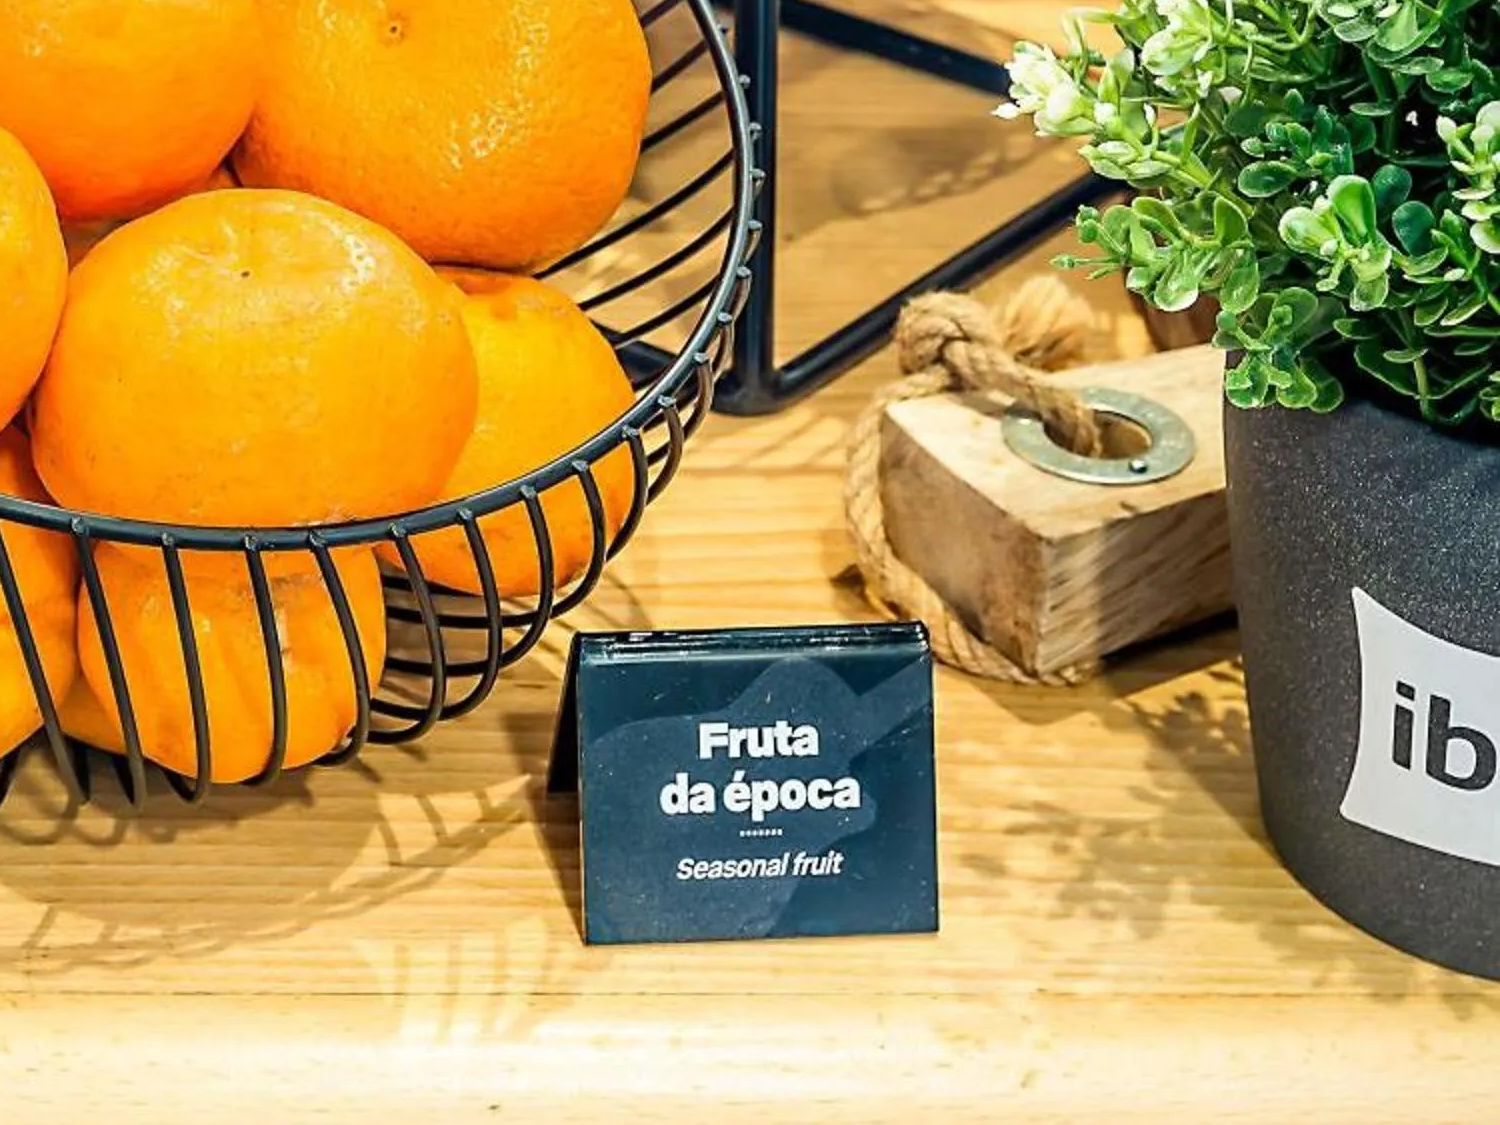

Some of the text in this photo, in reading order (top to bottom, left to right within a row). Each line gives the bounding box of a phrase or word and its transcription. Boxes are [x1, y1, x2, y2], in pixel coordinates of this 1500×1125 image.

[698, 720, 819, 759] Fruta
[1392, 680, 1498, 791] ib
[659, 769, 861, 822] da época
[676, 849, 845, 880] Seasonal fruit
